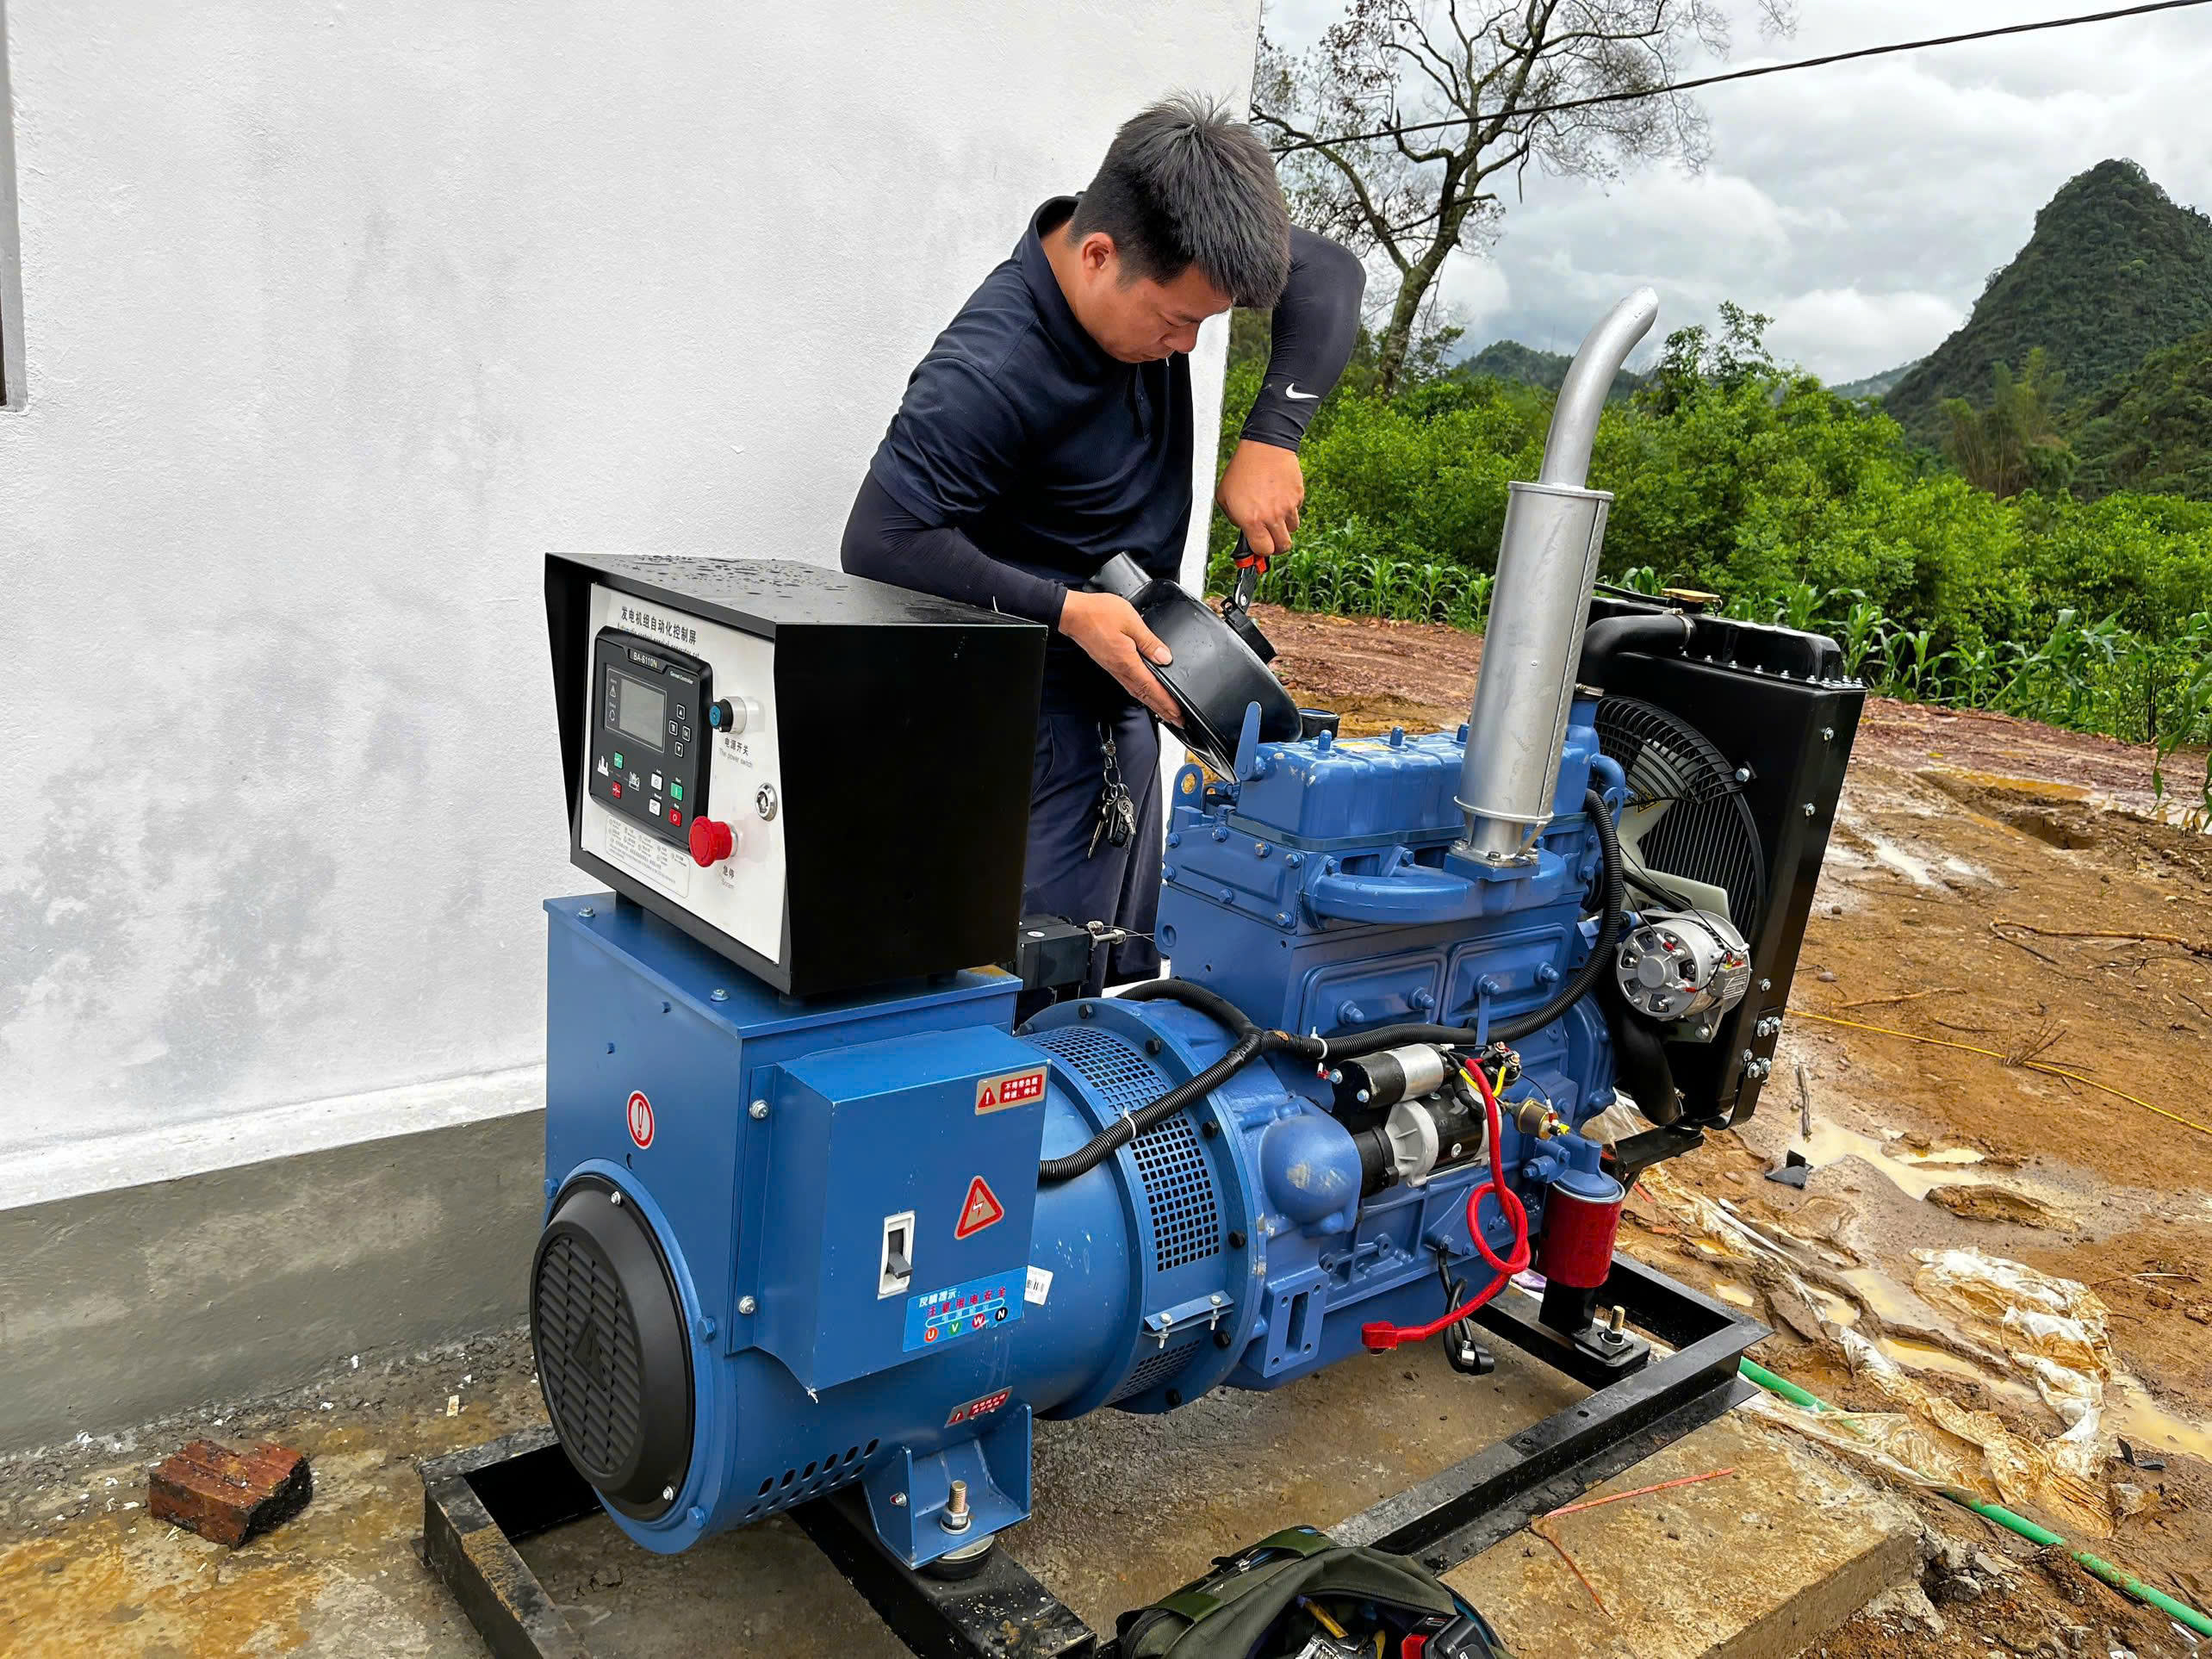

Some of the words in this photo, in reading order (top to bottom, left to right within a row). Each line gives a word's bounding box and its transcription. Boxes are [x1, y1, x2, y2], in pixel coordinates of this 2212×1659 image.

[620, 606, 697, 645] 发电机组自动化控制屏
[724, 736, 749, 756] 电源开关
[723, 865, 735, 879] 急停
[928, 1329, 935, 1339] U
[951, 1322, 959, 1333] V
[973, 1316, 984, 1325] W
[997, 1310, 1005, 1319] N
